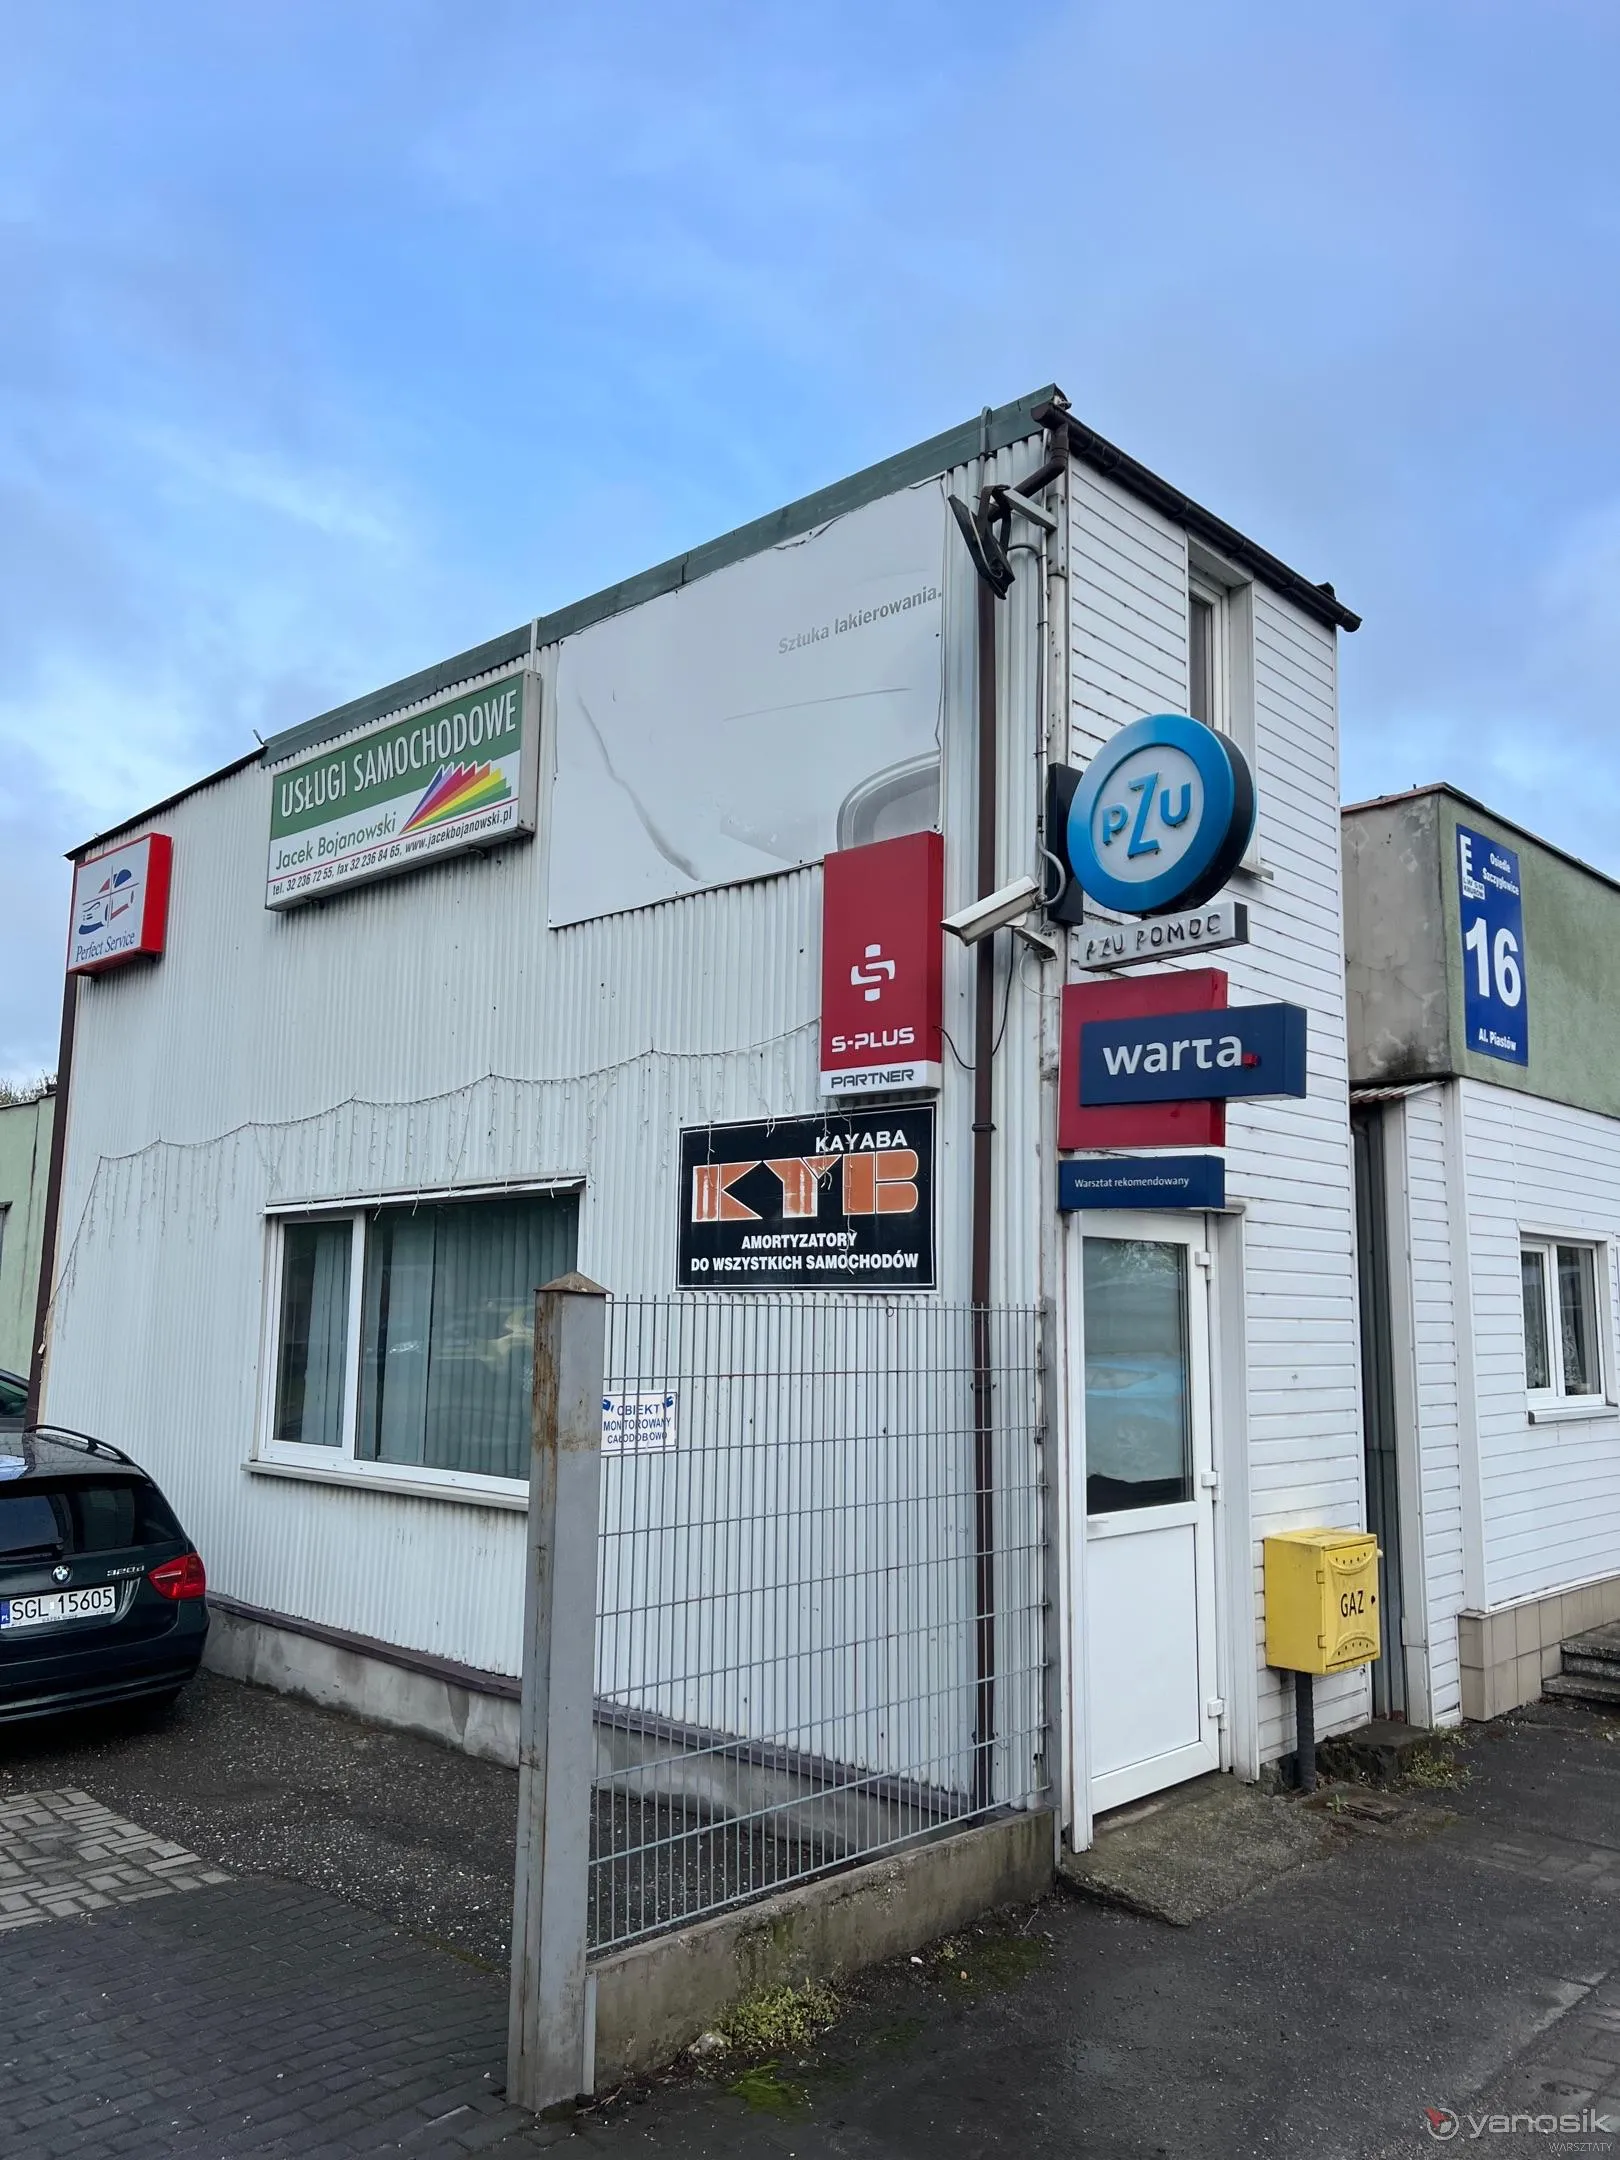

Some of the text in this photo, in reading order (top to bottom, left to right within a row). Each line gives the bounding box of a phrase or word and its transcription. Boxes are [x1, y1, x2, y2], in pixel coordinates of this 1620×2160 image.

[778, 585, 943, 655] Sztuka lakierowania.
[281, 689, 518, 817] USŁUGI SAMOCHODOWE
[1102, 772, 1192, 860] PZU
[273, 882, 285, 895] tel.
[286, 879, 297, 892] 32
[297, 876, 311, 889] 236
[312, 872, 322, 885] 72
[336, 862, 349, 877] fax
[350, 857, 360, 871] 32
[361, 853, 376, 868] 236
[377, 849, 388, 862] 84
[405, 806, 512, 853] www.jacekbojanowski.pl
[276, 811, 397, 870] Jacek Bojanowski
[1490, 852, 1511, 873] Osiedle
[75, 930, 135, 962] Perfect Service
[1086, 914, 1222, 960] PZU POMOC
[1465, 916, 1522, 1008] 16
[831, 1026, 915, 1053] S-PLUS
[1489, 1031, 1517, 1052] Piastów
[831, 1068, 914, 1089] PARTNER
[815, 1129, 908, 1153] KAYABA
[691, 1148, 919, 1223] KYB
[1075, 1175, 1189, 1188] Warsztat rekomendowany
[741, 1232, 857, 1250] AMORTYZATORY
[691, 1250, 919, 1272] DO WSZYSTKICH SAMOCHODÓW
[617, 1403, 660, 1416] OBIEKT
[603, 1417, 671, 1431] MONTOROWANY
[12, 1588, 112, 1620] SGL 15605
[1340, 1590, 1364, 1617] GAZ
